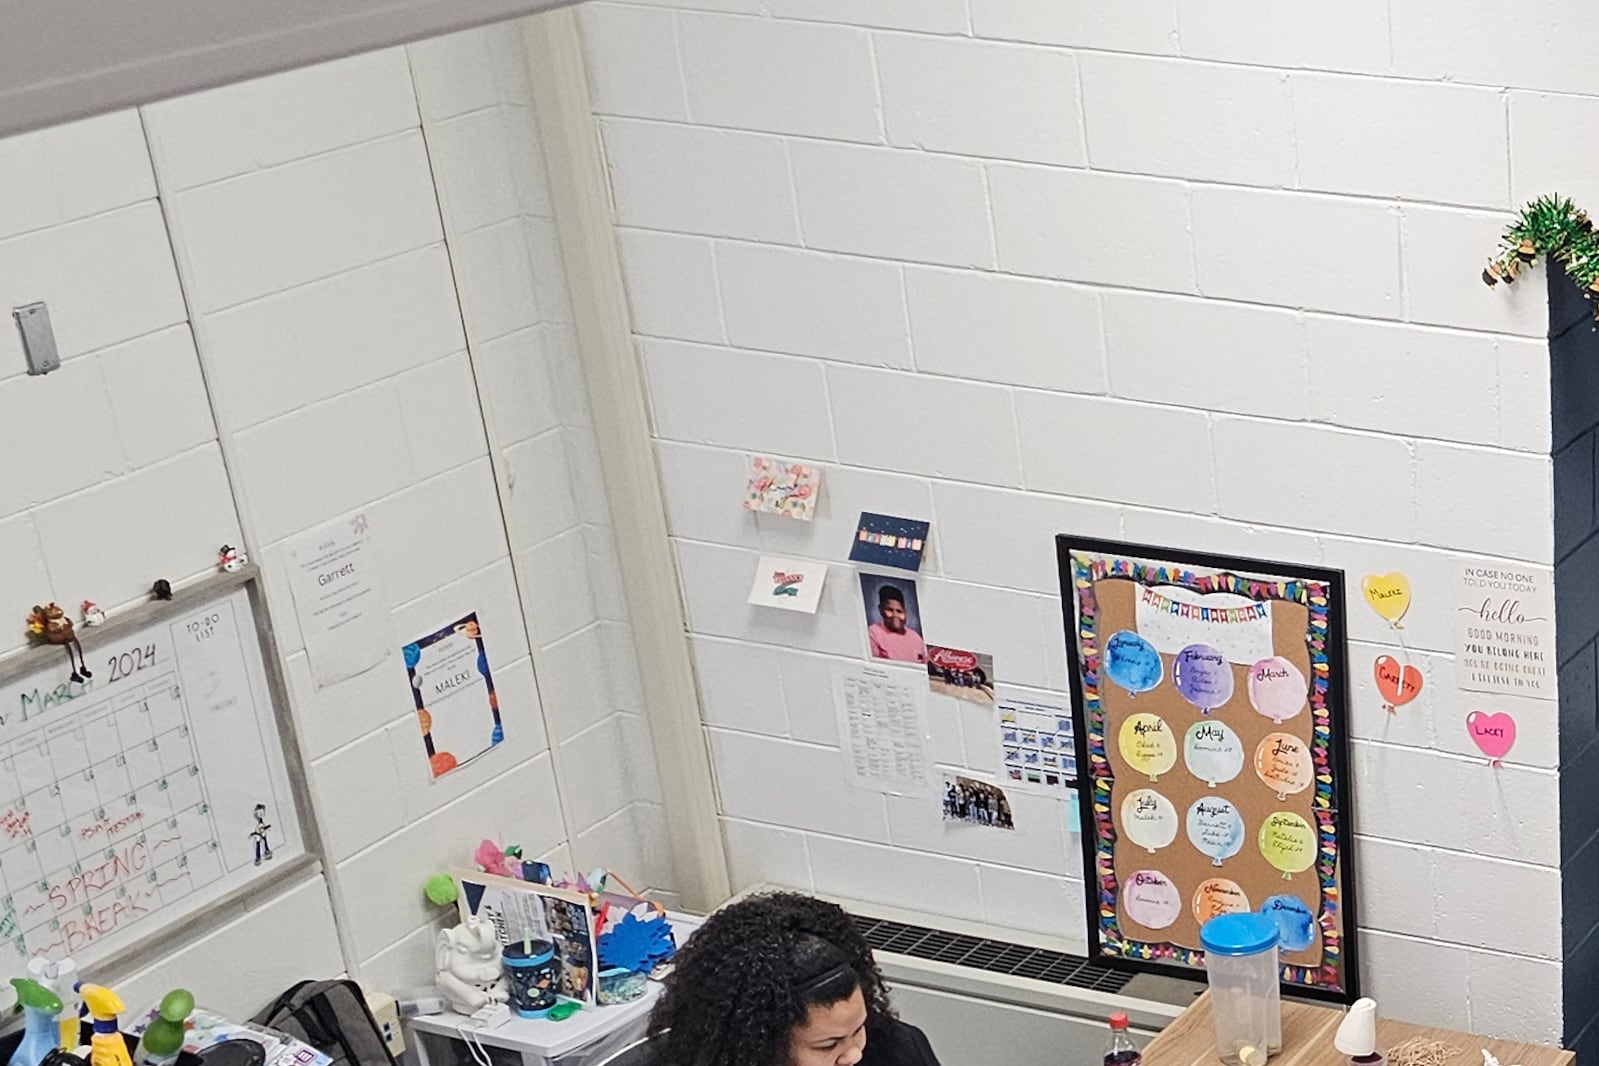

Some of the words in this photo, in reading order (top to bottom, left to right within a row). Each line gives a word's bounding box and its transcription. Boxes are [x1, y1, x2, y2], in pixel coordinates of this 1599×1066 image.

[318, 563, 356, 587] Garrett
[1465, 568, 1475, 577] IN
[1476, 569, 1499, 580] CASE
[1500, 572, 1515, 581] NO
[1515, 574, 1534, 584] ONE
[1464, 578, 1487, 588] TOLD
[1488, 581, 1507, 590] YOU
[1508, 583, 1537, 594] TODAY
[1466, 598, 1538, 624] hello
[195, 626, 216, 642] LIST
[1467, 627, 1493, 640] GOOD
[1495, 631, 1540, 647] MORNING
[1464, 643, 1484, 654] YOU
[1486, 645, 1520, 659] BELONG
[107, 643, 157, 684] 2024
[434, 670, 472, 695] MALEKI
[1256, 668, 1290, 682] March
[1134, 719, 1163, 739] April
[1195, 725, 1225, 742] May
[1272, 739, 1299, 756] June
[1137, 795, 1157, 813] July
[1196, 802, 1230, 818] August
[48, 843, 148, 911] SPRING
[60, 893, 148, 953] BREAK
